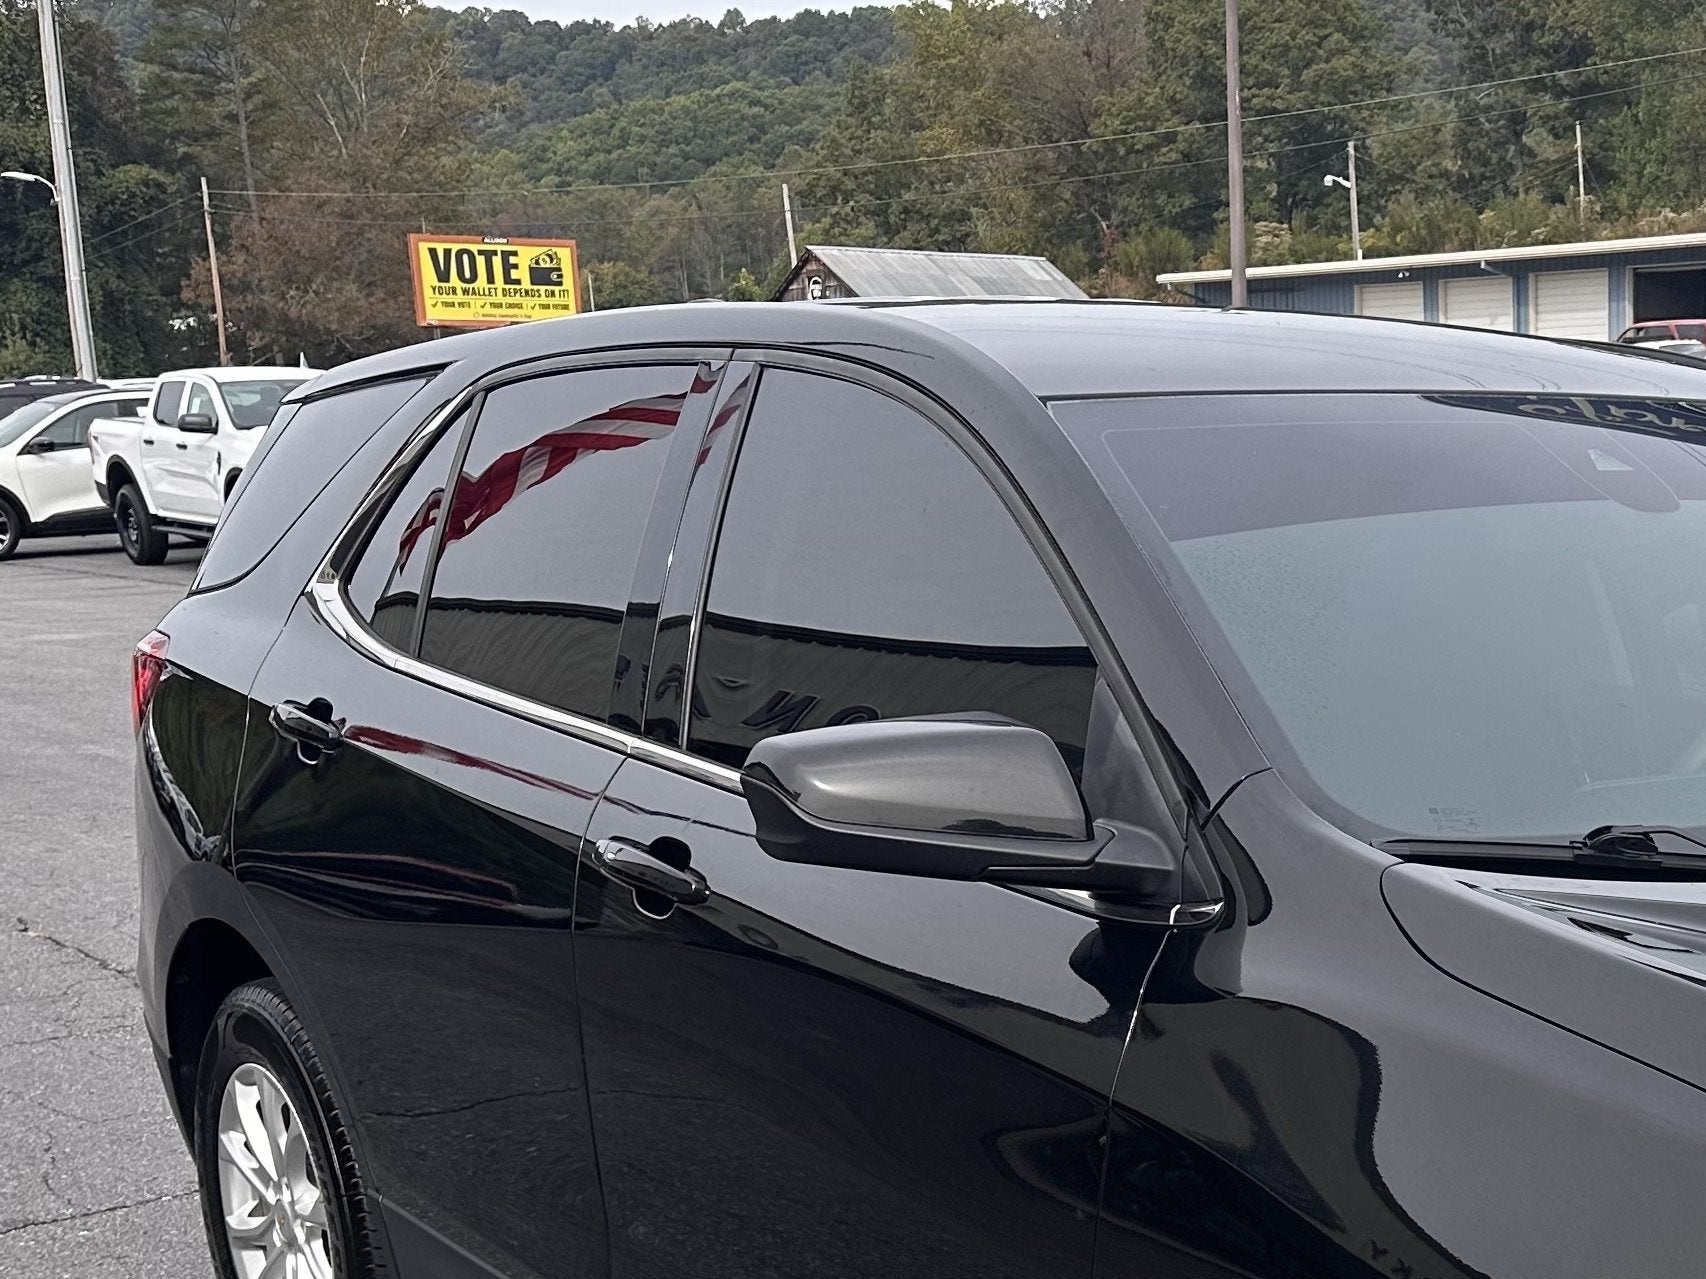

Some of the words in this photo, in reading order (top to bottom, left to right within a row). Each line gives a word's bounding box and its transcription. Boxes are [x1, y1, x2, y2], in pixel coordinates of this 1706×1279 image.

[427, 247, 521, 286] VOTE
[431, 285, 457, 297] YOUR
[461, 286, 498, 298] WALLET
[502, 287, 542, 299] DEPENDS
[544, 288, 557, 299] ON
[558, 289, 570, 300] IT!
